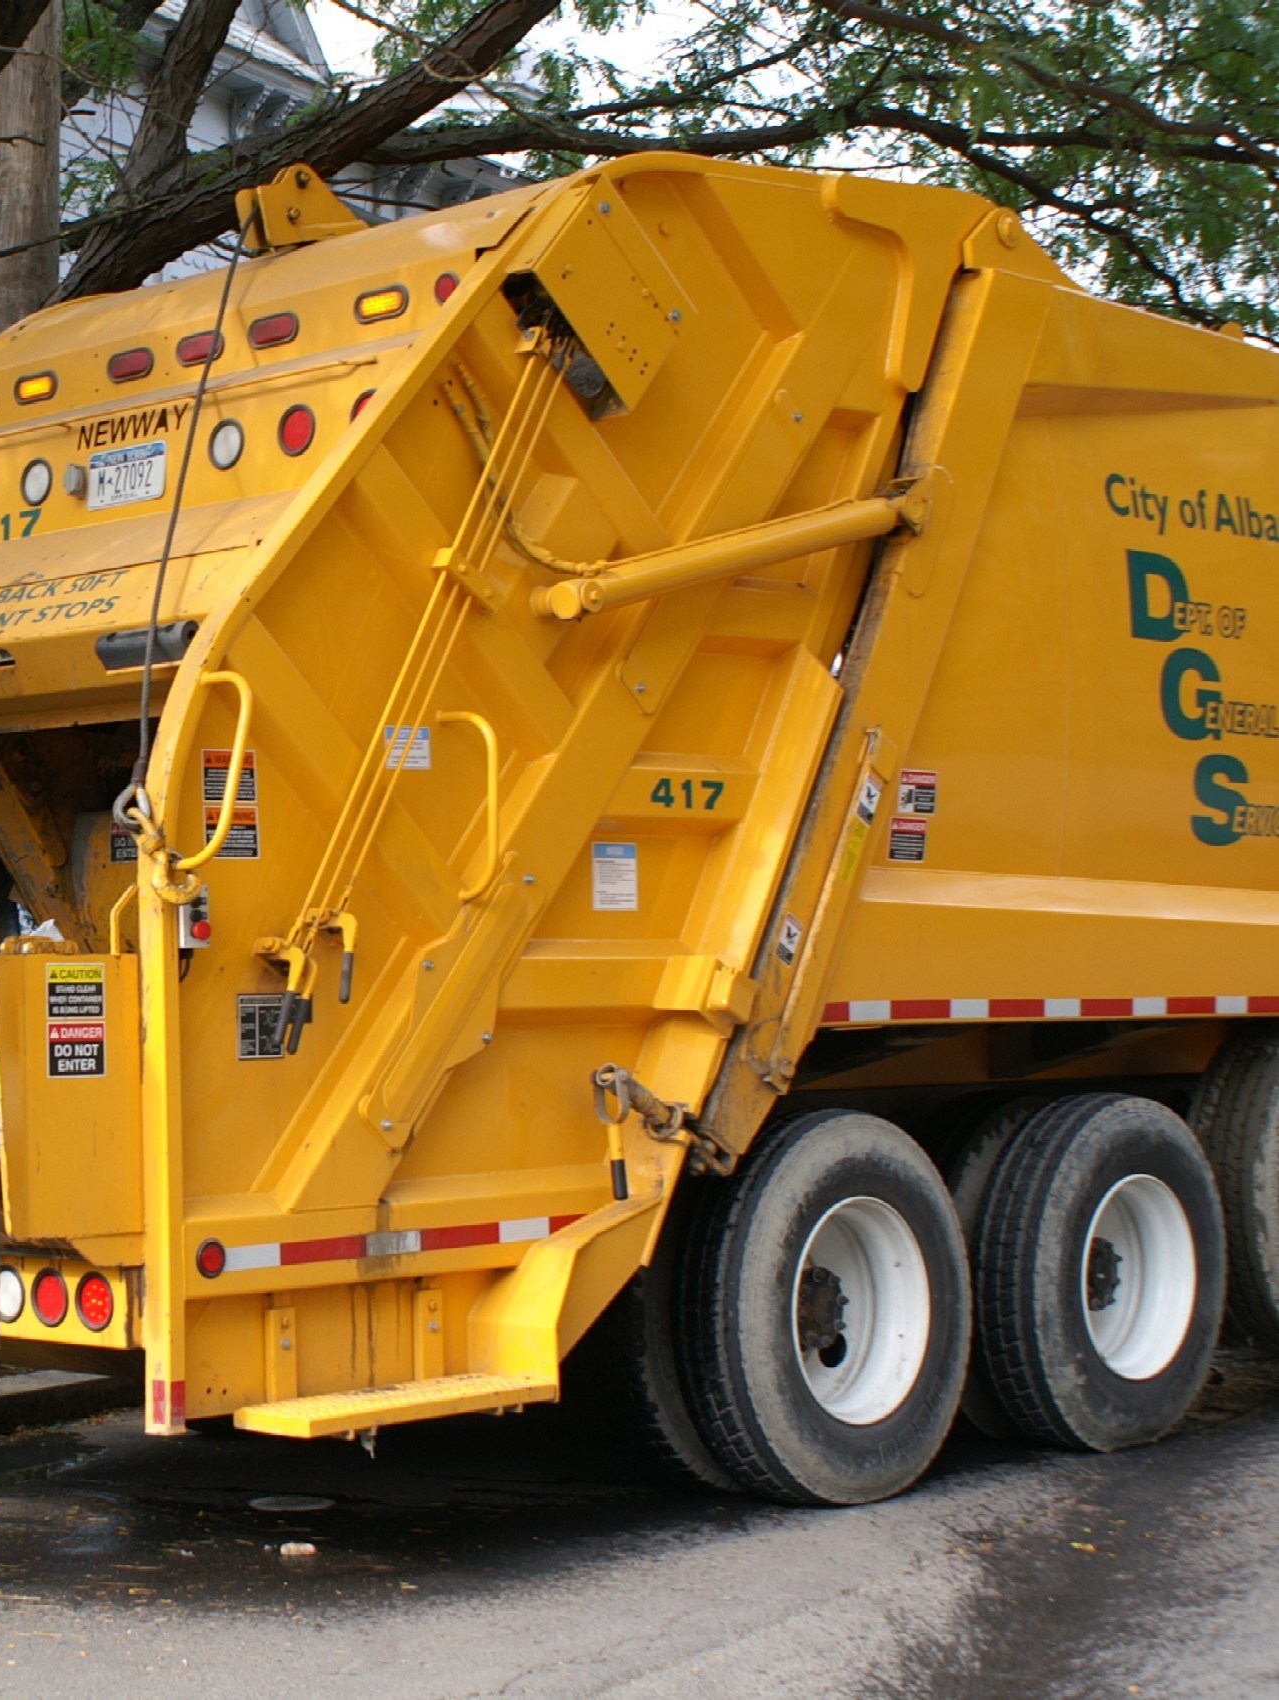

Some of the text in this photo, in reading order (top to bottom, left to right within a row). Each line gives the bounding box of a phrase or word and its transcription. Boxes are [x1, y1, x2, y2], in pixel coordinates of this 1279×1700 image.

[77, 403, 189, 451] NEWWAY
[1105, 473, 1168, 535] City
[1180, 489, 1207, 529] of
[32, 595, 121, 623] STOPS
[1216, 605, 1247, 639] OF
[650, 778, 725, 810] 417
[59, 969, 102, 980] CAUTION
[60, 1027, 103, 1039] DANGER
[54, 1044, 100, 1057] DO NOT
[58, 1059, 96, 1072] ENTER
